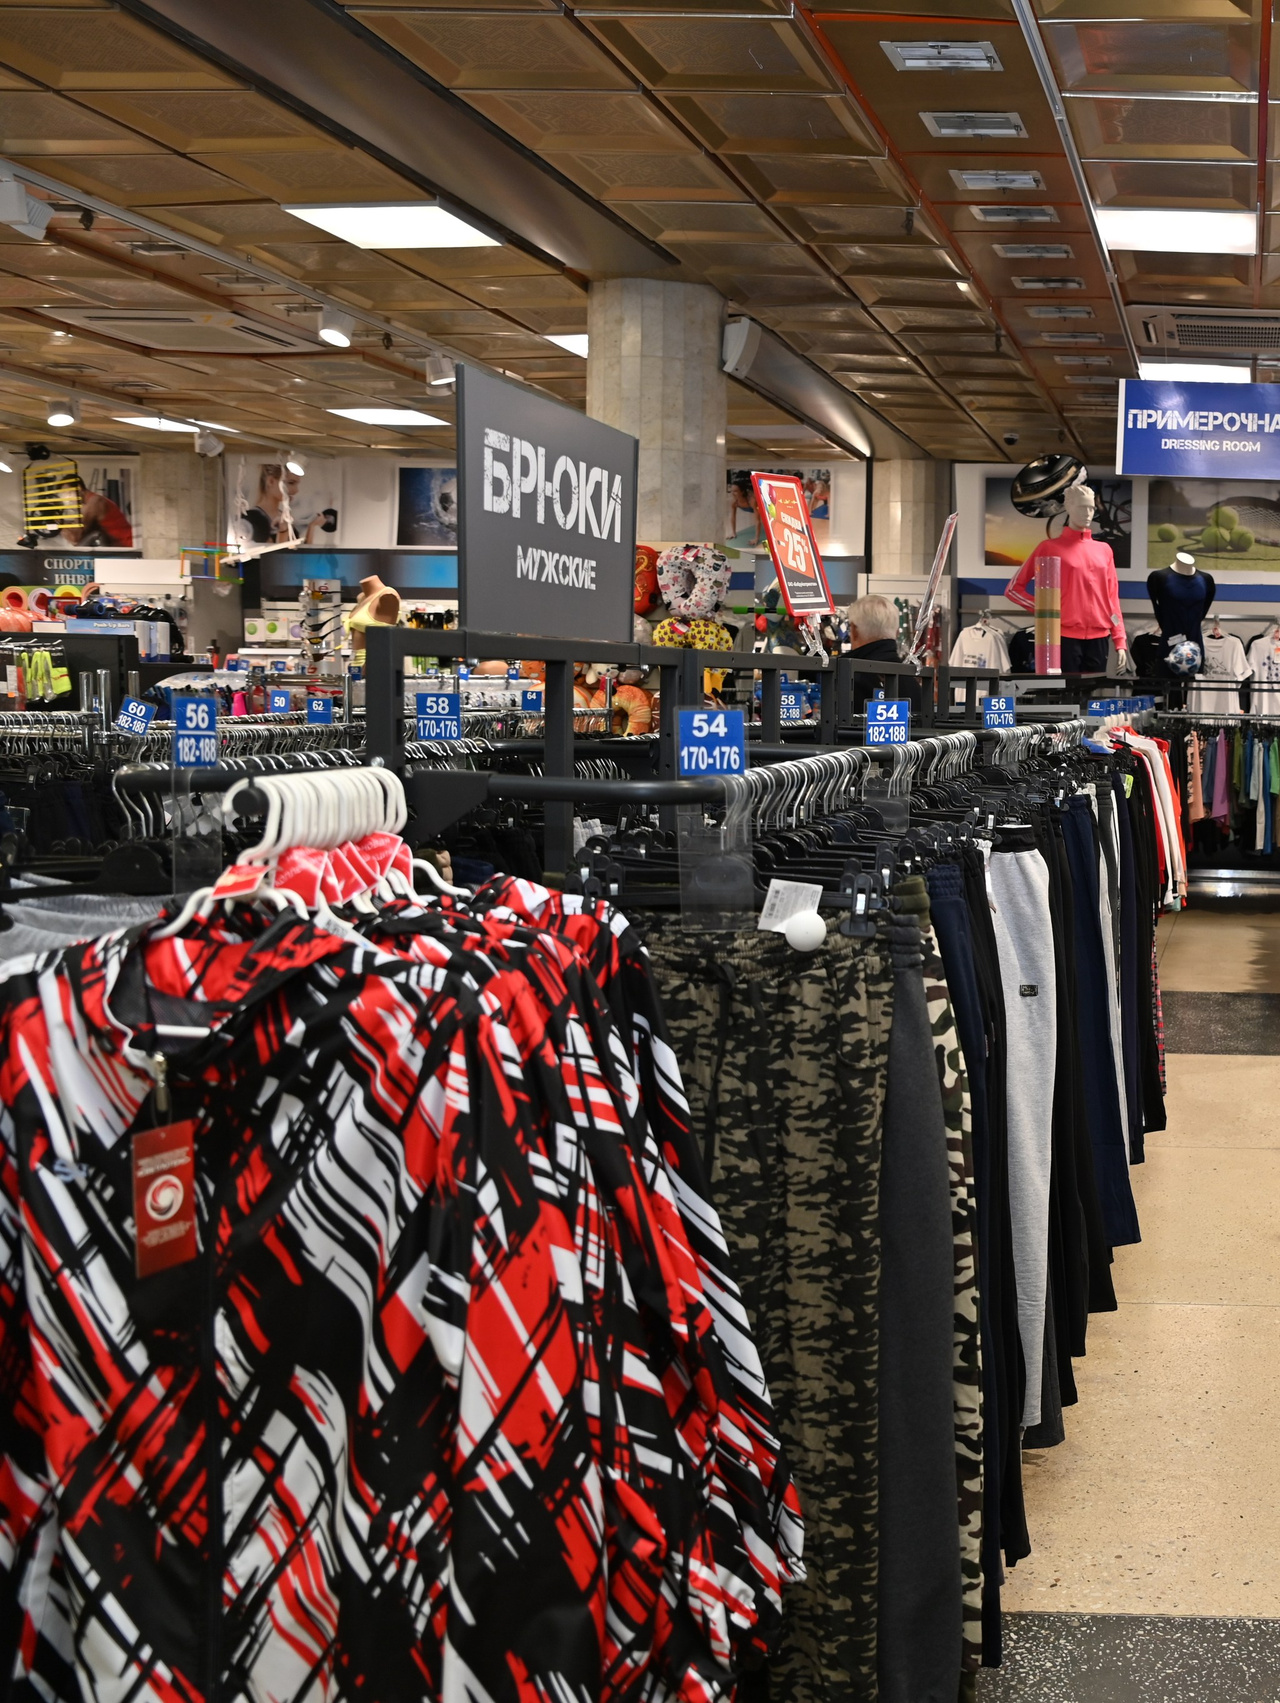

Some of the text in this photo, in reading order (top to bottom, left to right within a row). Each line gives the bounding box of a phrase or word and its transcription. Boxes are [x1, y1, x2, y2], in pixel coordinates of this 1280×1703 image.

[1161, 438, 1261, 453] DRESSING ROOM
[483, 427, 622, 543] БРЮКИ
[516, 545, 597, 591] МУЖСКИЕ
[274, 697, 286, 708] 50
[527, 692, 537, 700] 64
[781, 694, 796, 705] 58
[991, 698, 1006, 710] 56
[128, 702, 147, 717] 60
[312, 701, 324, 711] 62
[426, 697, 449, 714] 58
[876, 704, 899, 721] 54
[117, 714, 146, 734] 182-188
[186, 703, 209, 729] 56
[986, 713, 1014, 725] 170-176
[418, 720, 458, 738] 170-176
[692, 713, 728, 738] 54
[868, 726, 906, 742] 182-188
[178, 737, 217, 763] 182-188
[681, 746, 740, 770] 170-176
